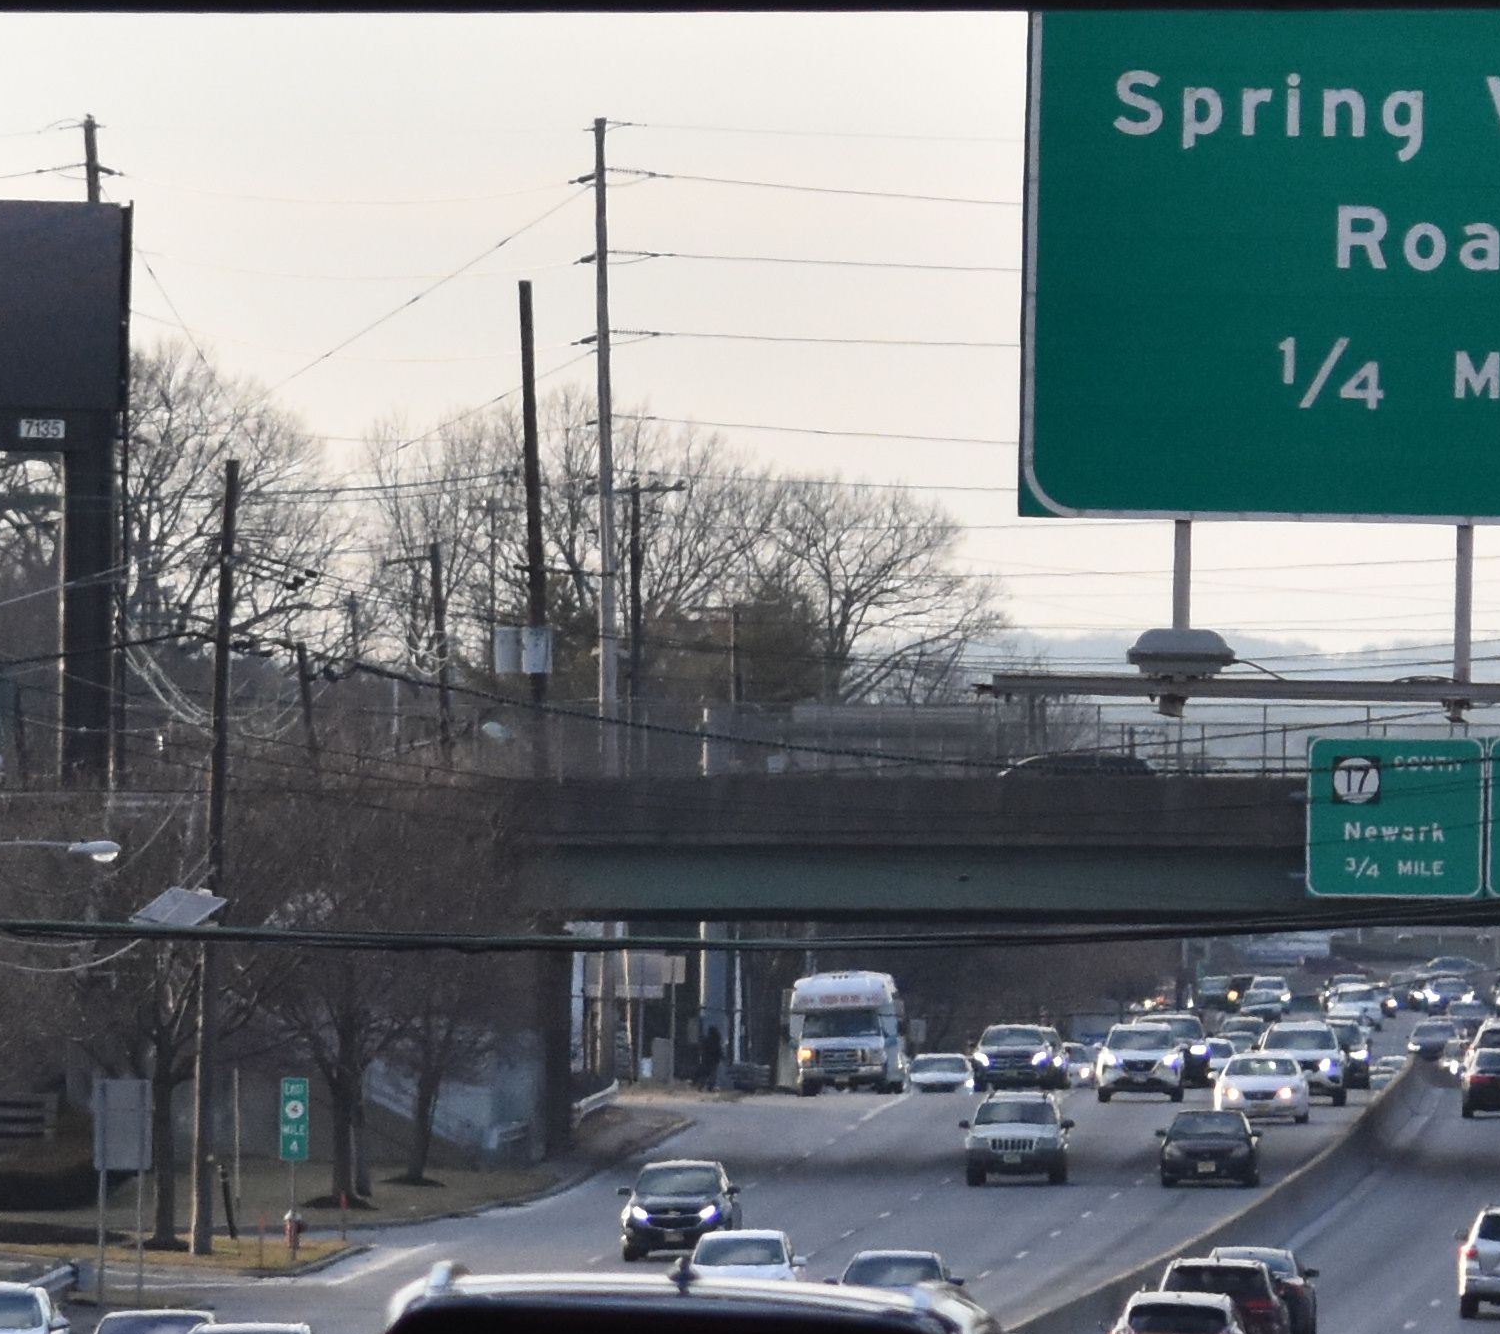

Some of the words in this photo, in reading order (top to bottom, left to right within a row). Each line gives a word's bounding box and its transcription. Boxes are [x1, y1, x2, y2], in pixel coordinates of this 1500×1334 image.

[1114, 70, 1424, 161] Spring
[1279, 337, 1384, 410] 1/4
[24, 420, 62, 438] 7135
[1346, 765, 1370, 794] 17
[1394, 755, 1462, 772] SOUTH
[1344, 821, 1445, 842] Newark
[1345, 856, 1380, 878] 3/4
[1398, 860, 1444, 877] MILE
